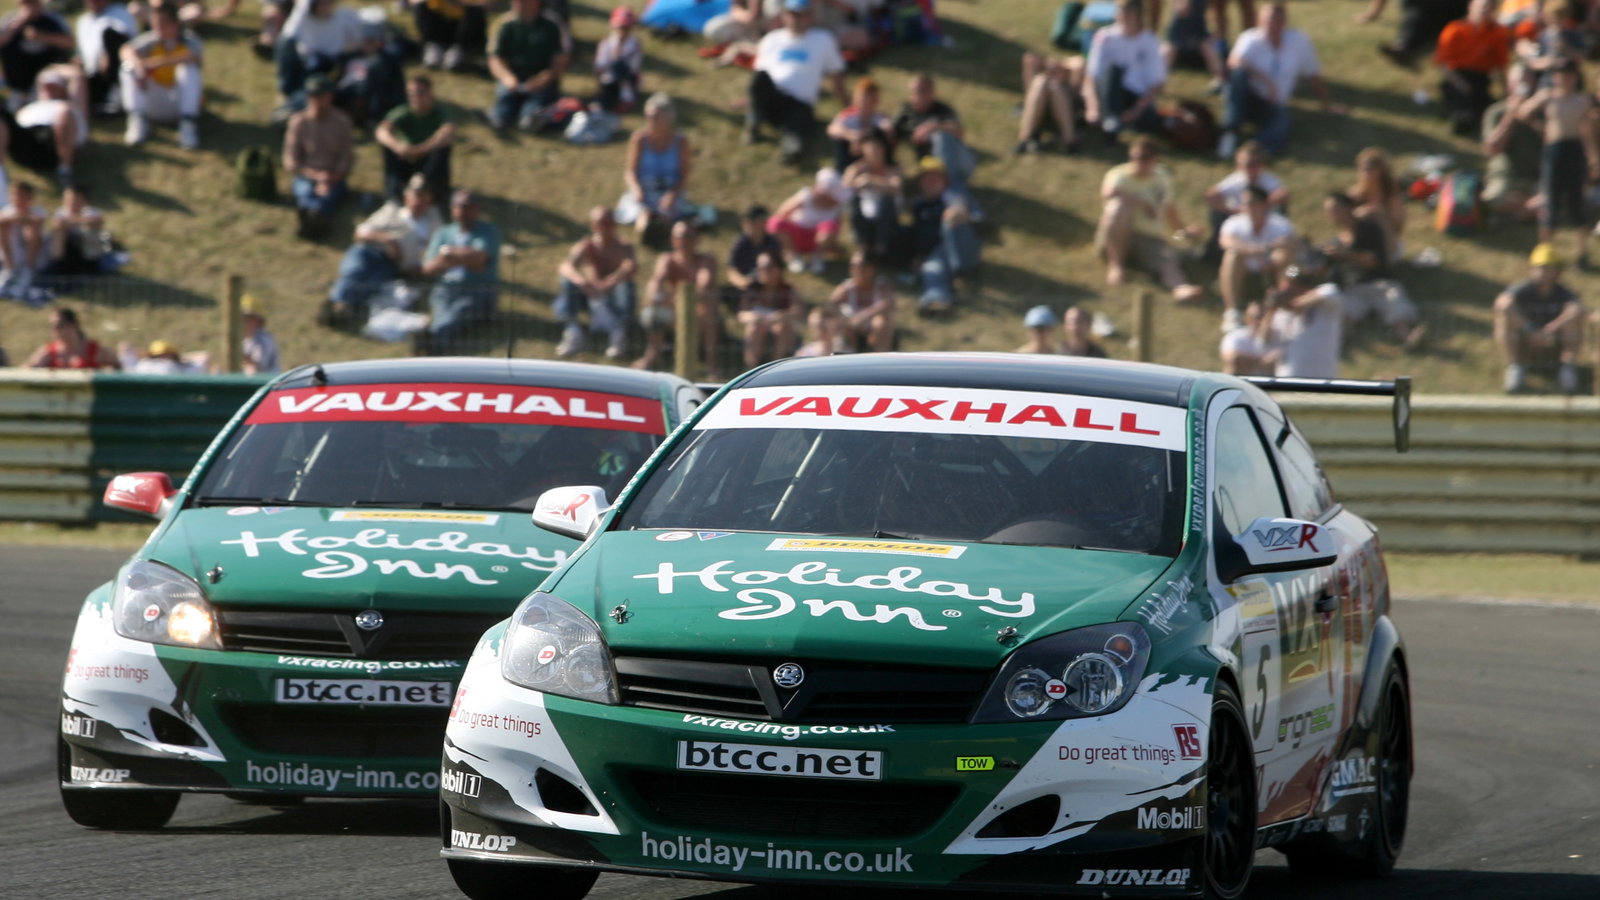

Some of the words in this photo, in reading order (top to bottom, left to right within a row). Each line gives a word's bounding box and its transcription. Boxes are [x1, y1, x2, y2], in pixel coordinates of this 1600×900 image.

[278, 391, 646, 423] VAUXHALL
[739, 396, 1160, 436] VAUXHALL
[220, 528, 568, 571] Holiday
[1253, 524, 1319, 552] VXR
[302, 550, 498, 585] Inn
[633, 560, 1035, 618] Holiday
[718, 588, 948, 631] Inn
[85, 665, 110, 680] great
[114, 664, 149, 683] things
[277, 655, 460, 674] vxracing.co.uk
[284, 678, 445, 704] btcc.net
[1252, 644, 1271, 740] 5
[458, 709, 470, 724] Do
[470, 713, 499, 729] great
[503, 715, 541, 738] things
[682, 714, 896, 741] vxracing.co.uk
[1059, 746, 1080, 761] Do
[1085, 745, 1127, 764] great
[1132, 745, 1176, 765] things
[1173, 726, 1202, 757] RS
[685, 740, 875, 777] btcc.net
[961, 759, 988, 769] TOW
[441, 766, 464, 794] obil
[1137, 806, 1193, 830] Mobil
[641, 831, 913, 872] holiday-inn.co.uk
[1075, 868, 1191, 886] DUNLOP
